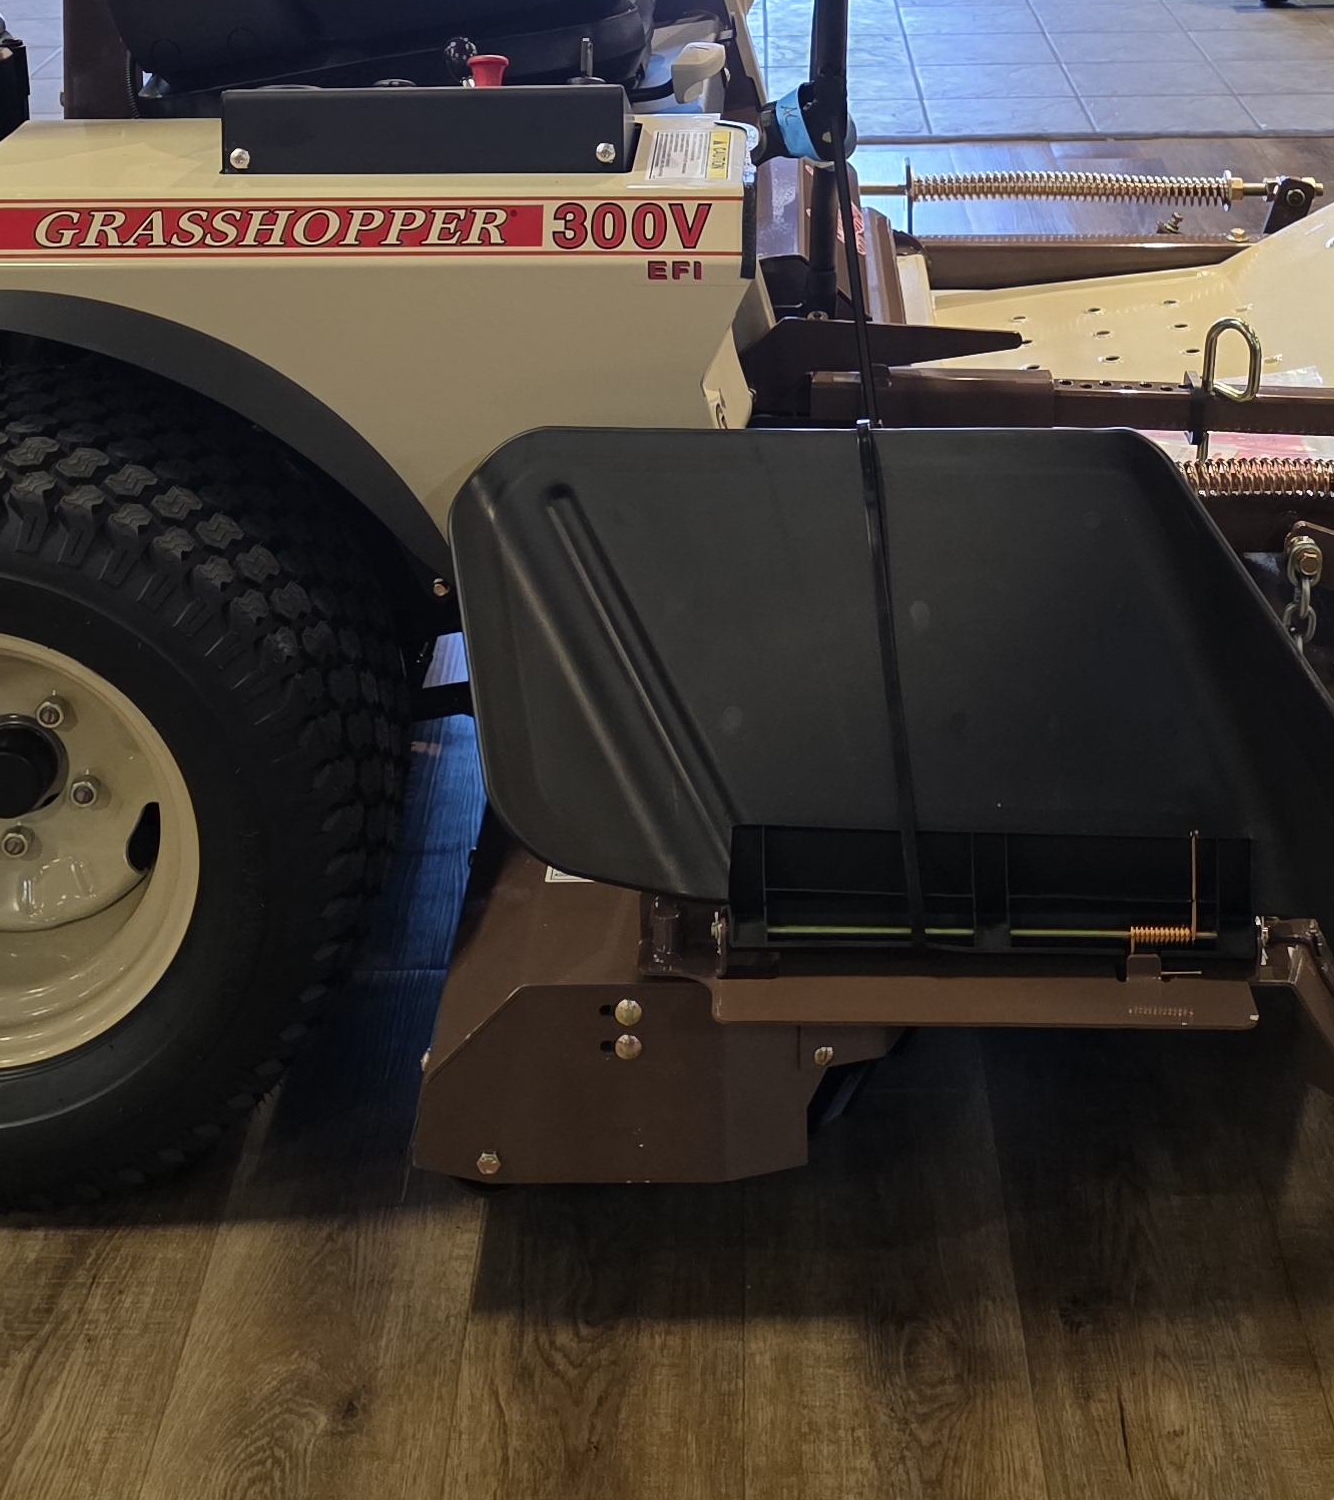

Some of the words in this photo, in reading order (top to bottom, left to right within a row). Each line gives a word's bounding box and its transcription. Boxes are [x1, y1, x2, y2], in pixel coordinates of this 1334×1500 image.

[33, 205, 509, 249] GRASSHOPPER
[551, 202, 713, 251] 300V
[647, 259, 703, 282] EFI
